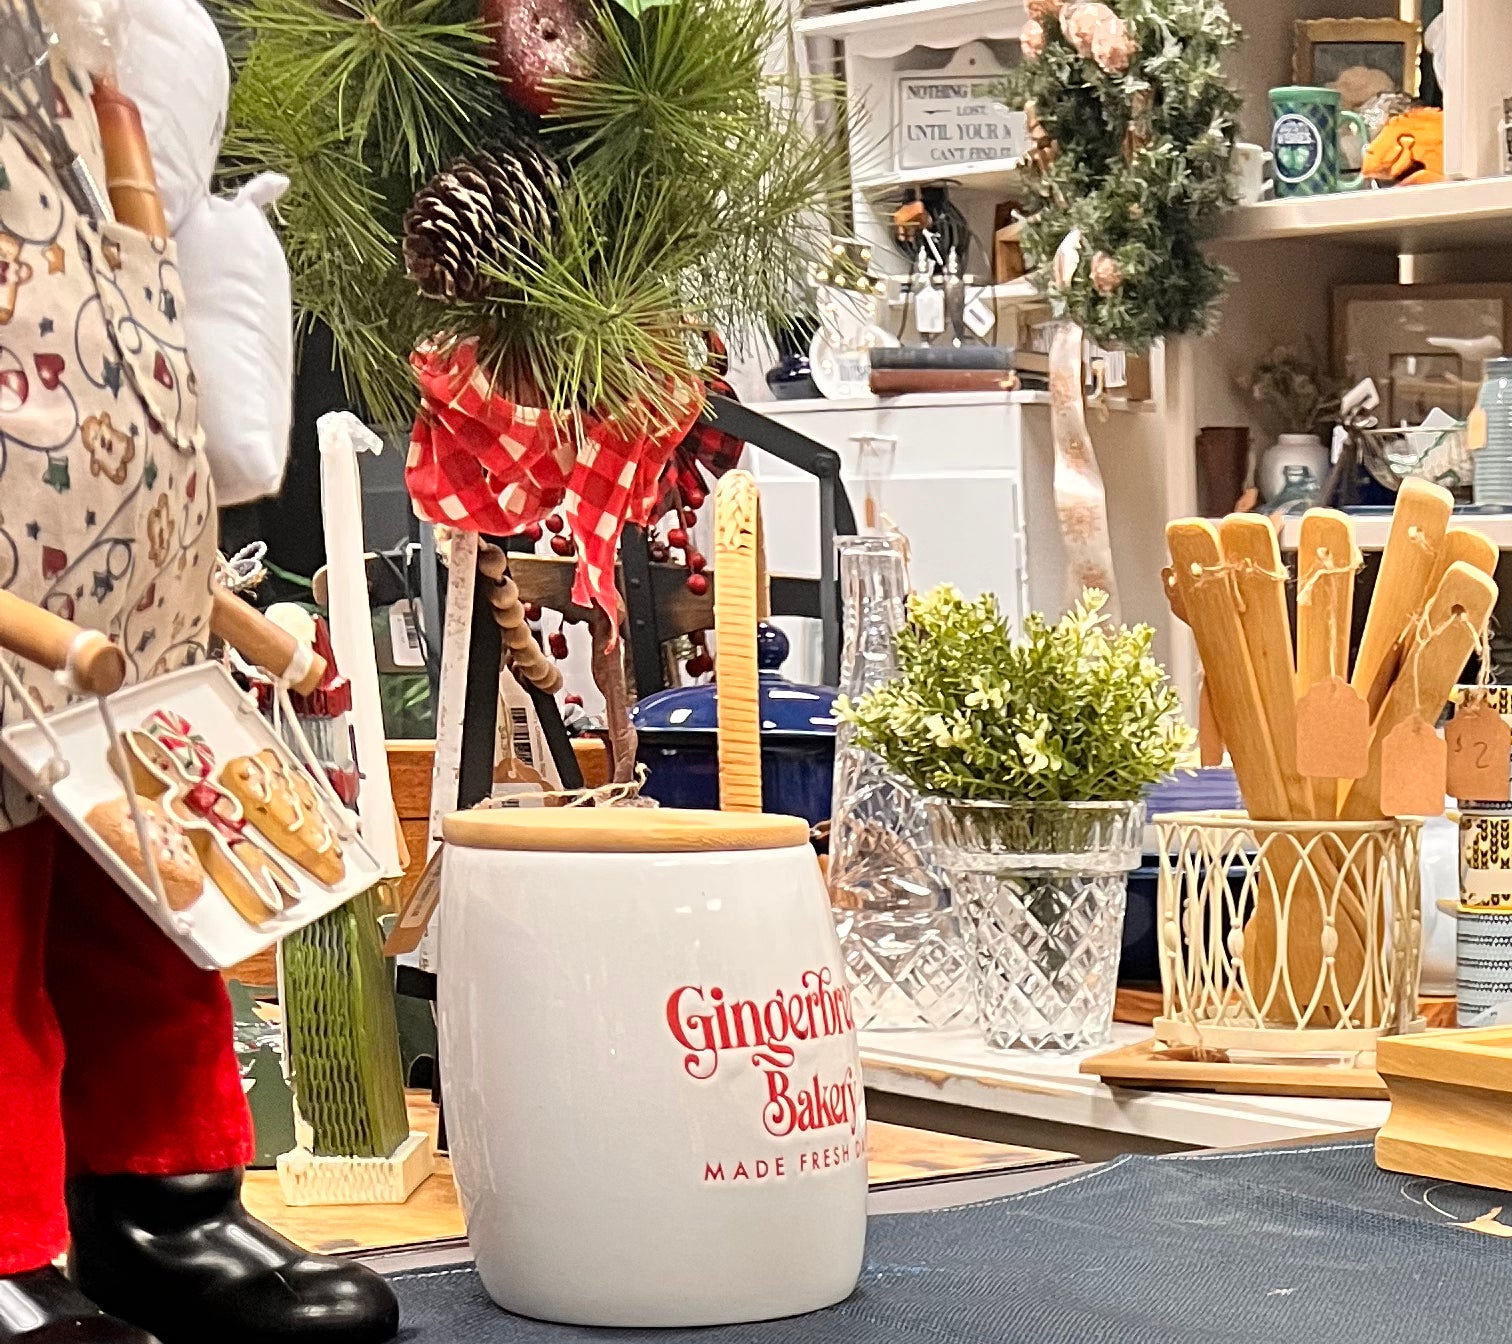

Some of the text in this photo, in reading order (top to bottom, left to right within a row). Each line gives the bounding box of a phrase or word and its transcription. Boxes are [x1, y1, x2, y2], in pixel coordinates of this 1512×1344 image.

[907, 124, 953, 141] UNTIL
[956, 123, 999, 140] YOUR
[763, 1066, 857, 1137] Bakery
[704, 1156, 786, 1181] MADE
[800, 1147, 850, 1172] FRESH
